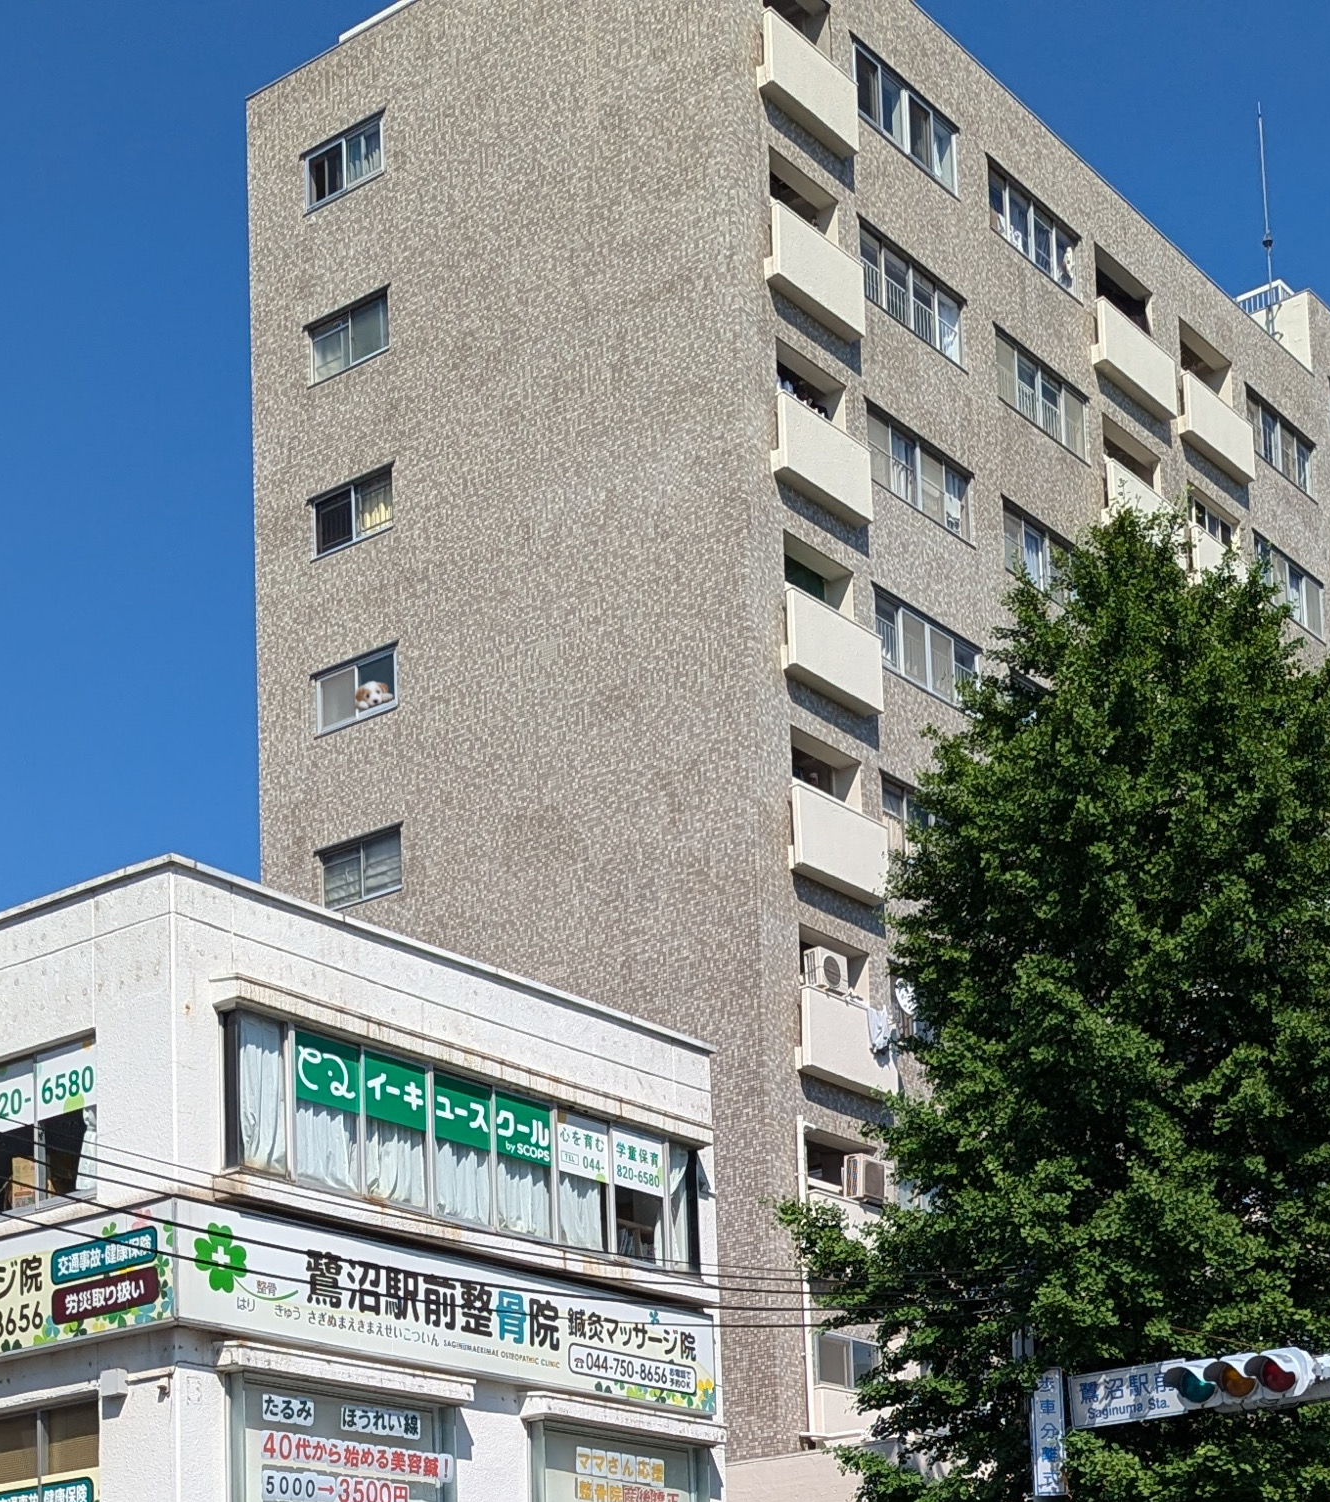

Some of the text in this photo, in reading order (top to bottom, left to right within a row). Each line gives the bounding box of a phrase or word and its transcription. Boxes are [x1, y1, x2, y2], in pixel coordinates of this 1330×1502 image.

[367, 1073, 550, 1148] イーキュースクール
[505, 1142, 551, 1162] by SCOPS
[616, 1141, 660, 1168] 学童保育
[65, 1279, 145, 1315] 労災取り扱い
[256, 1280, 278, 1297] 整骨
[306, 1249, 561, 1351] 鷺沼駅前整骨院
[236, 1297, 301, 1320] はり きゅう
[307, 1311, 439, 1347] さぎぬまえきまえせいこついん
[568, 1307, 696, 1362] 鍼灸マッサージ院
[540, 1359, 561, 1369] CLINIC
[586, 1352, 667, 1385] 044-750-8656
[264, 1396, 419, 1436] たるみ ほうれい線
[1087, 1398, 1170, 1420] Saginuma Sta.
[1038, 1377, 1060, 1486] 歩車分離式
[266, 1476, 316, 1499] 5000
